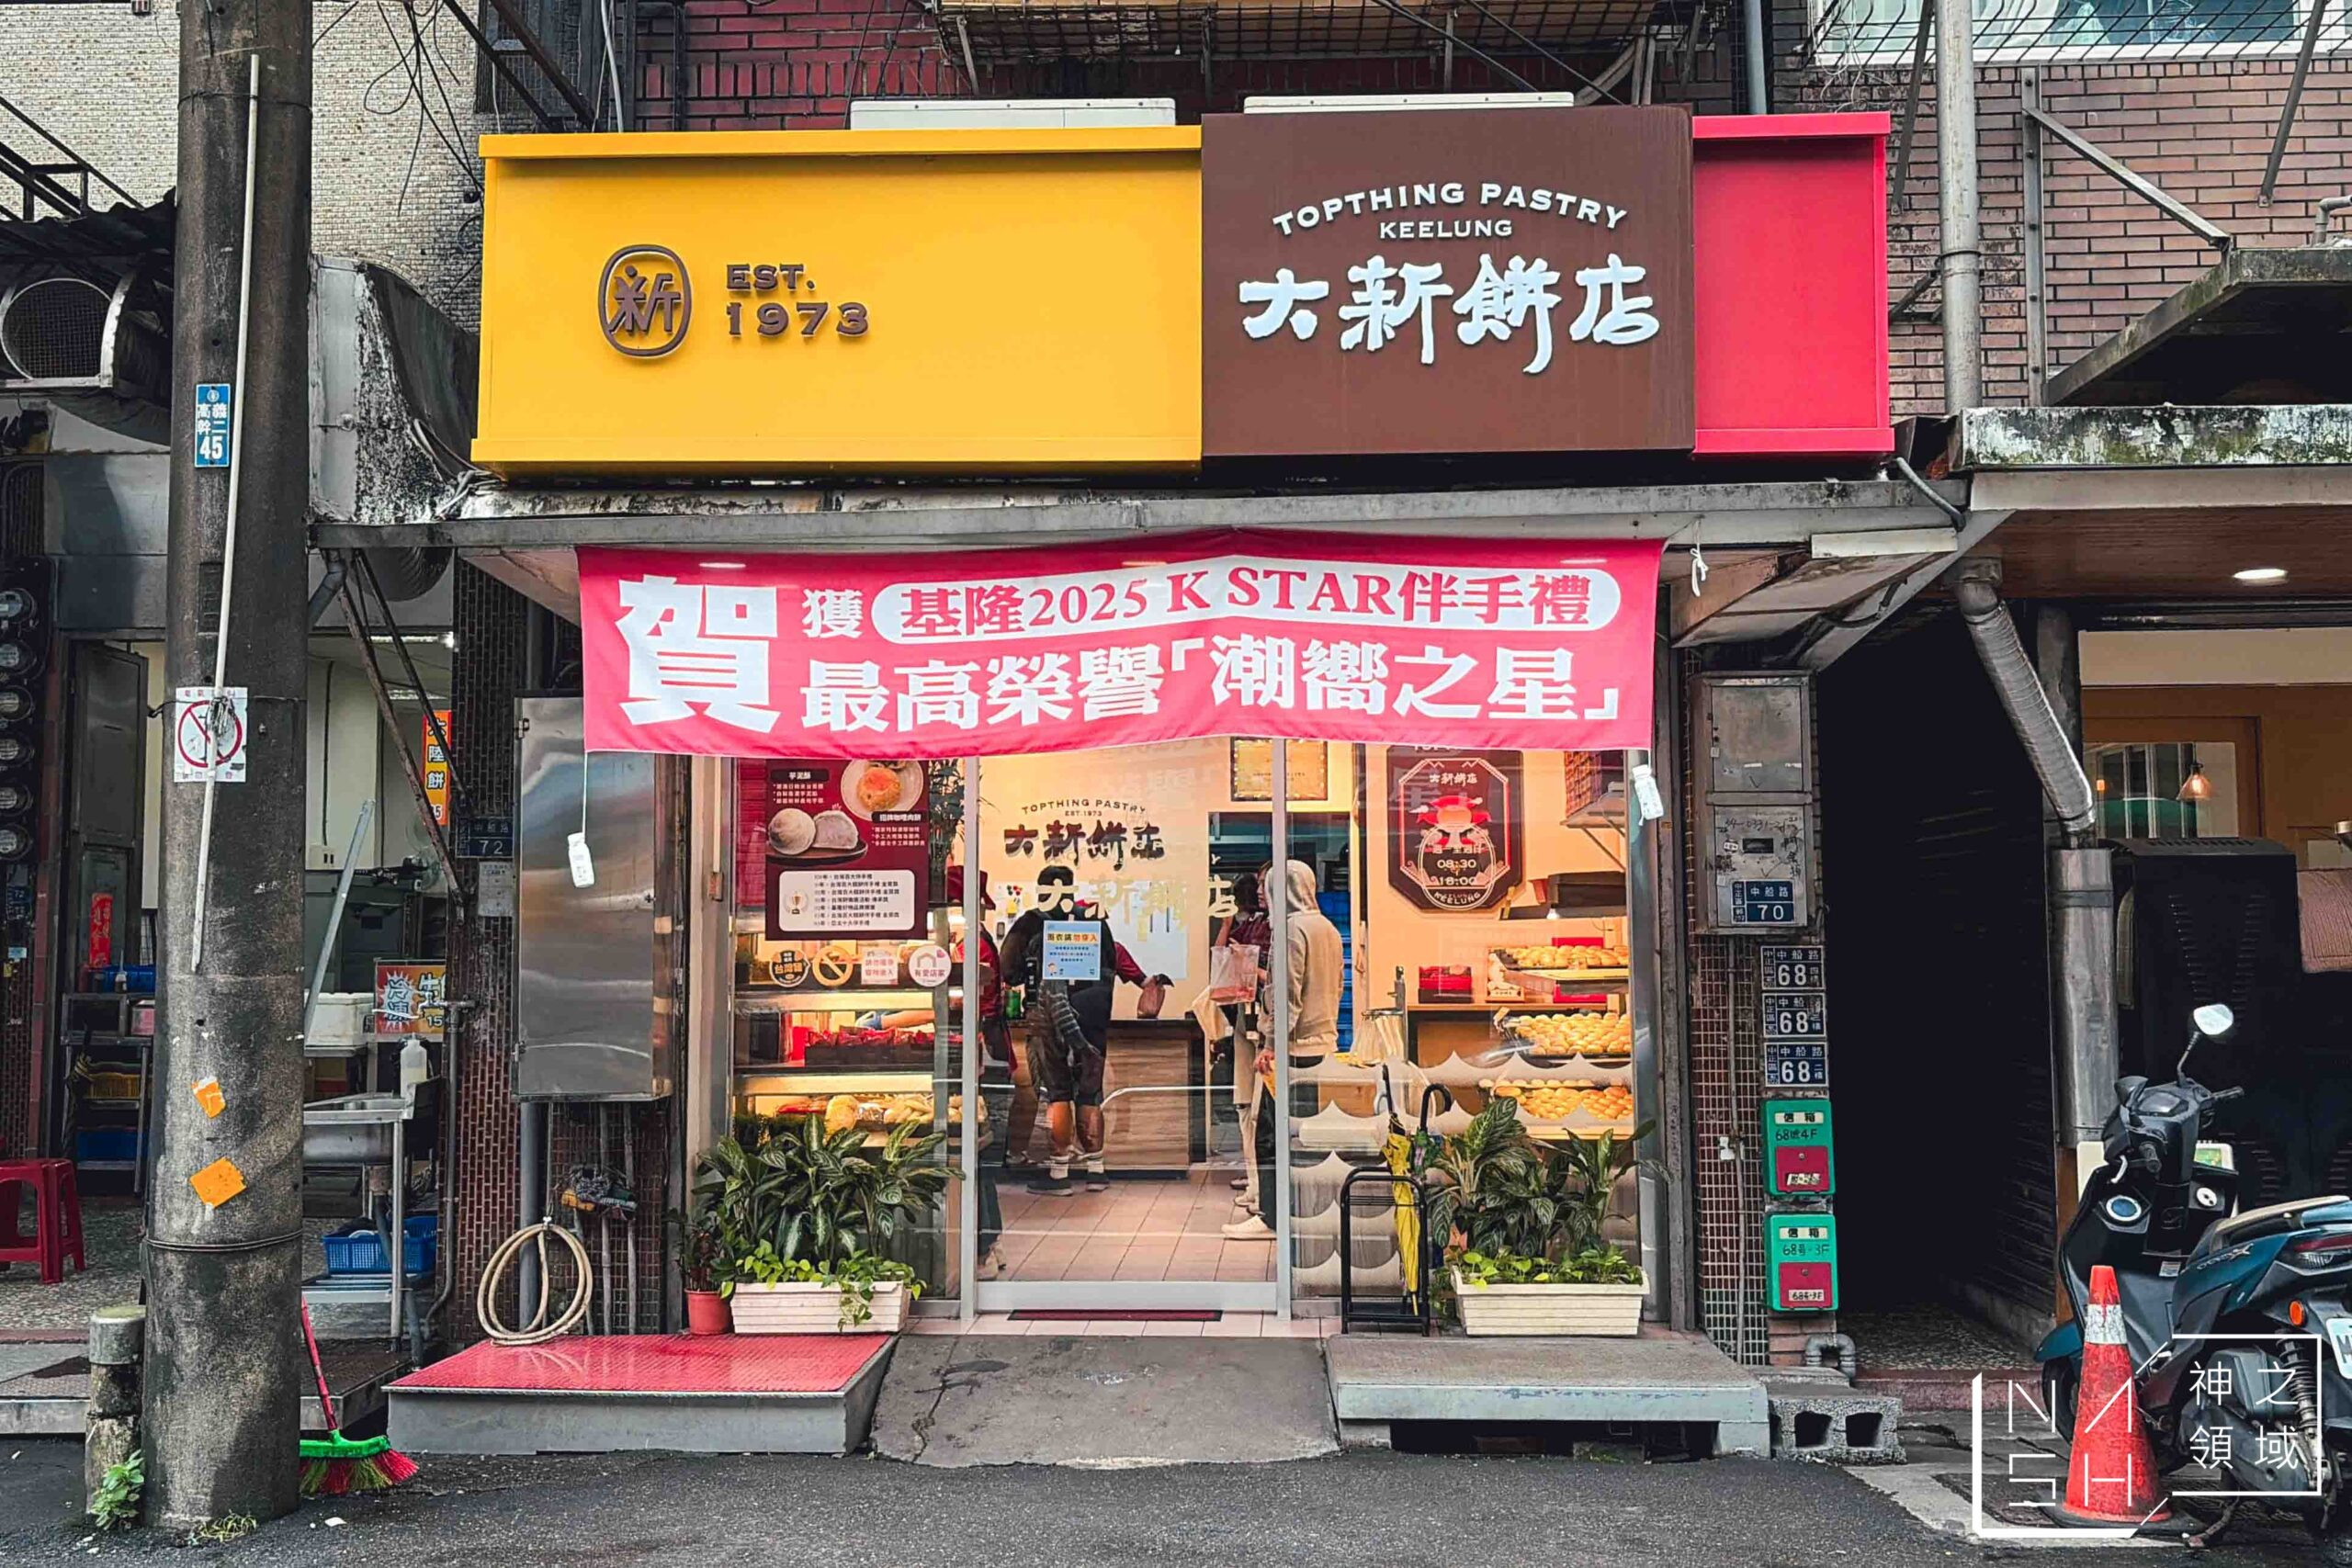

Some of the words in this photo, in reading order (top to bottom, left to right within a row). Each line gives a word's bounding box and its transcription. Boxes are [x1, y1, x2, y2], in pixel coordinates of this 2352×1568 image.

[1272, 183, 1464, 236] TOPTHING
[1480, 182, 1627, 230] PASTRY
[1380, 220, 1512, 240] KEELUNG
[726, 263, 815, 291] EST.
[606, 265, 681, 334] 新
[726, 300, 869, 336] 1973
[1238, 253, 1660, 375] 大新餅店
[199, 435, 223, 460] 45
[801, 588, 864, 639] 獲
[900, 579, 1147, 641] 基隆2025
[1166, 570, 1212, 613] K
[1227, 566, 1592, 626] STAR伴手禮
[615, 574, 781, 734] 賀
[1021, 798, 1090, 815] TOPTHING
[1095, 799, 1147, 814] PASTRY
[479, 840, 503, 854] 72
[1757, 904, 1784, 920] 70
[1778, 964, 1807, 986] 68
[1780, 1011, 1809, 1033] 68
[1781, 1060, 1811, 1083] 68
